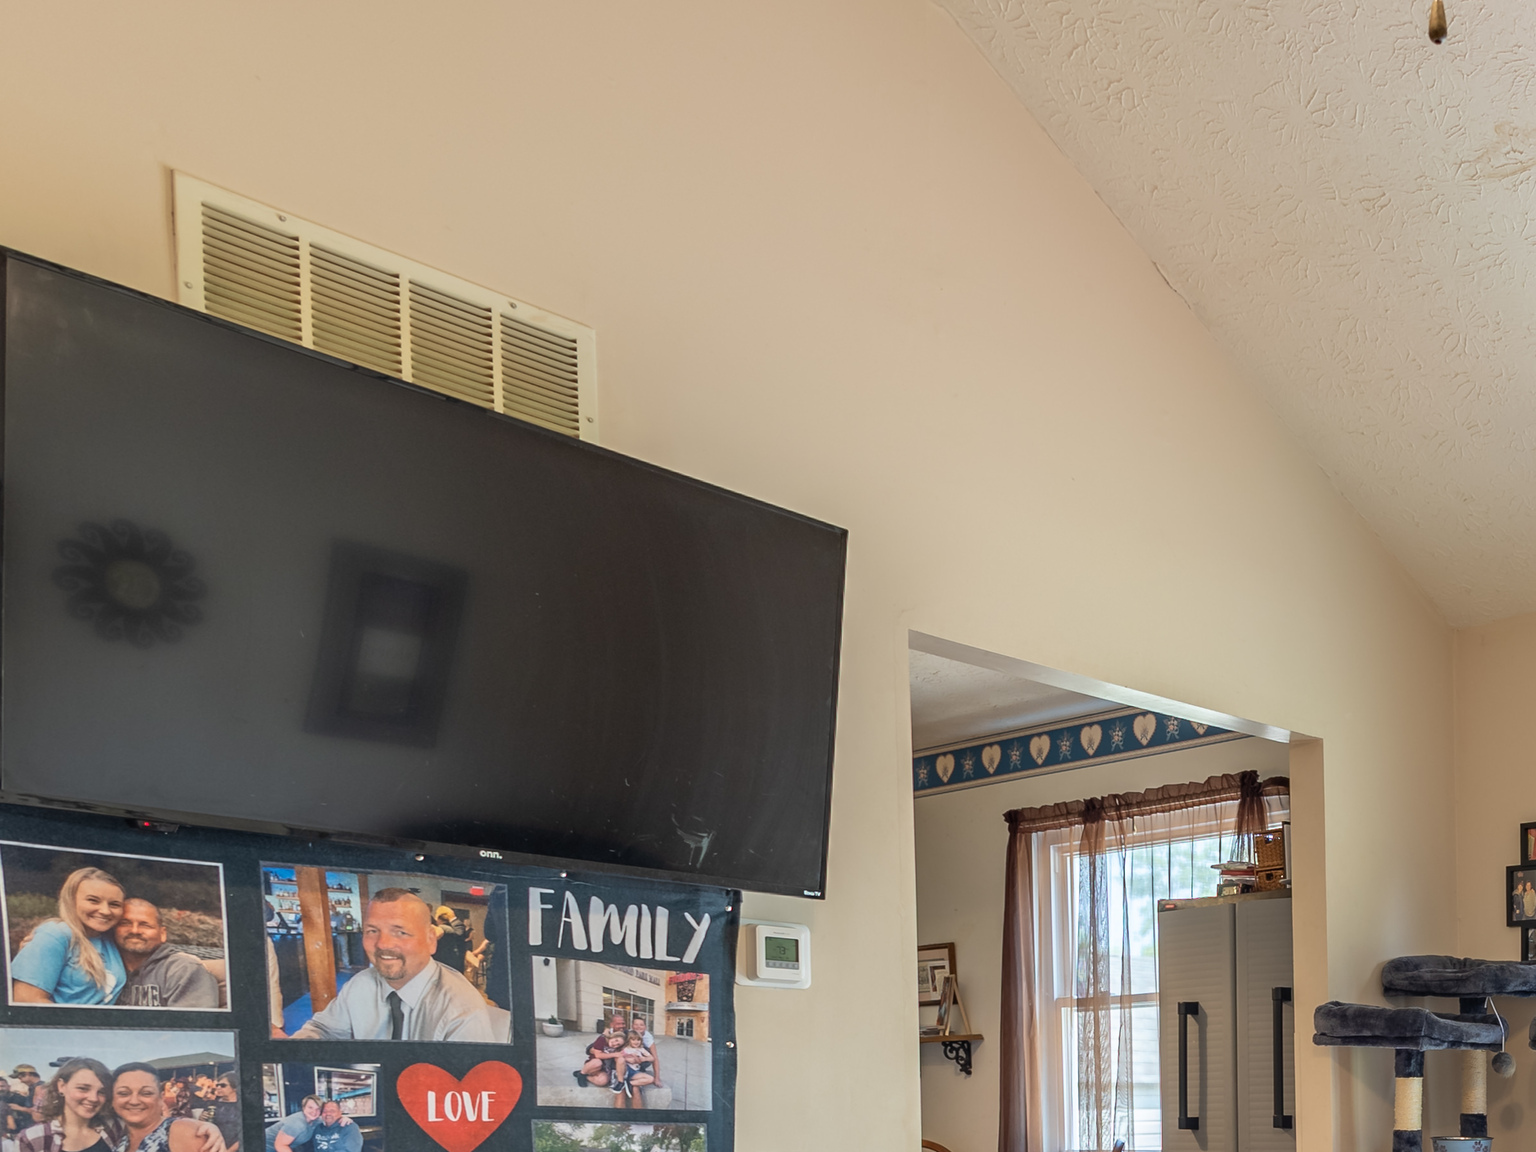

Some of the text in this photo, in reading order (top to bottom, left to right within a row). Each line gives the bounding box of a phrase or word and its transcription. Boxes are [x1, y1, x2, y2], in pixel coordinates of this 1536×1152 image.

[479, 849, 503, 860] onn.
[528, 886, 711, 964] FAMILY
[427, 1090, 497, 1122] LOVE
